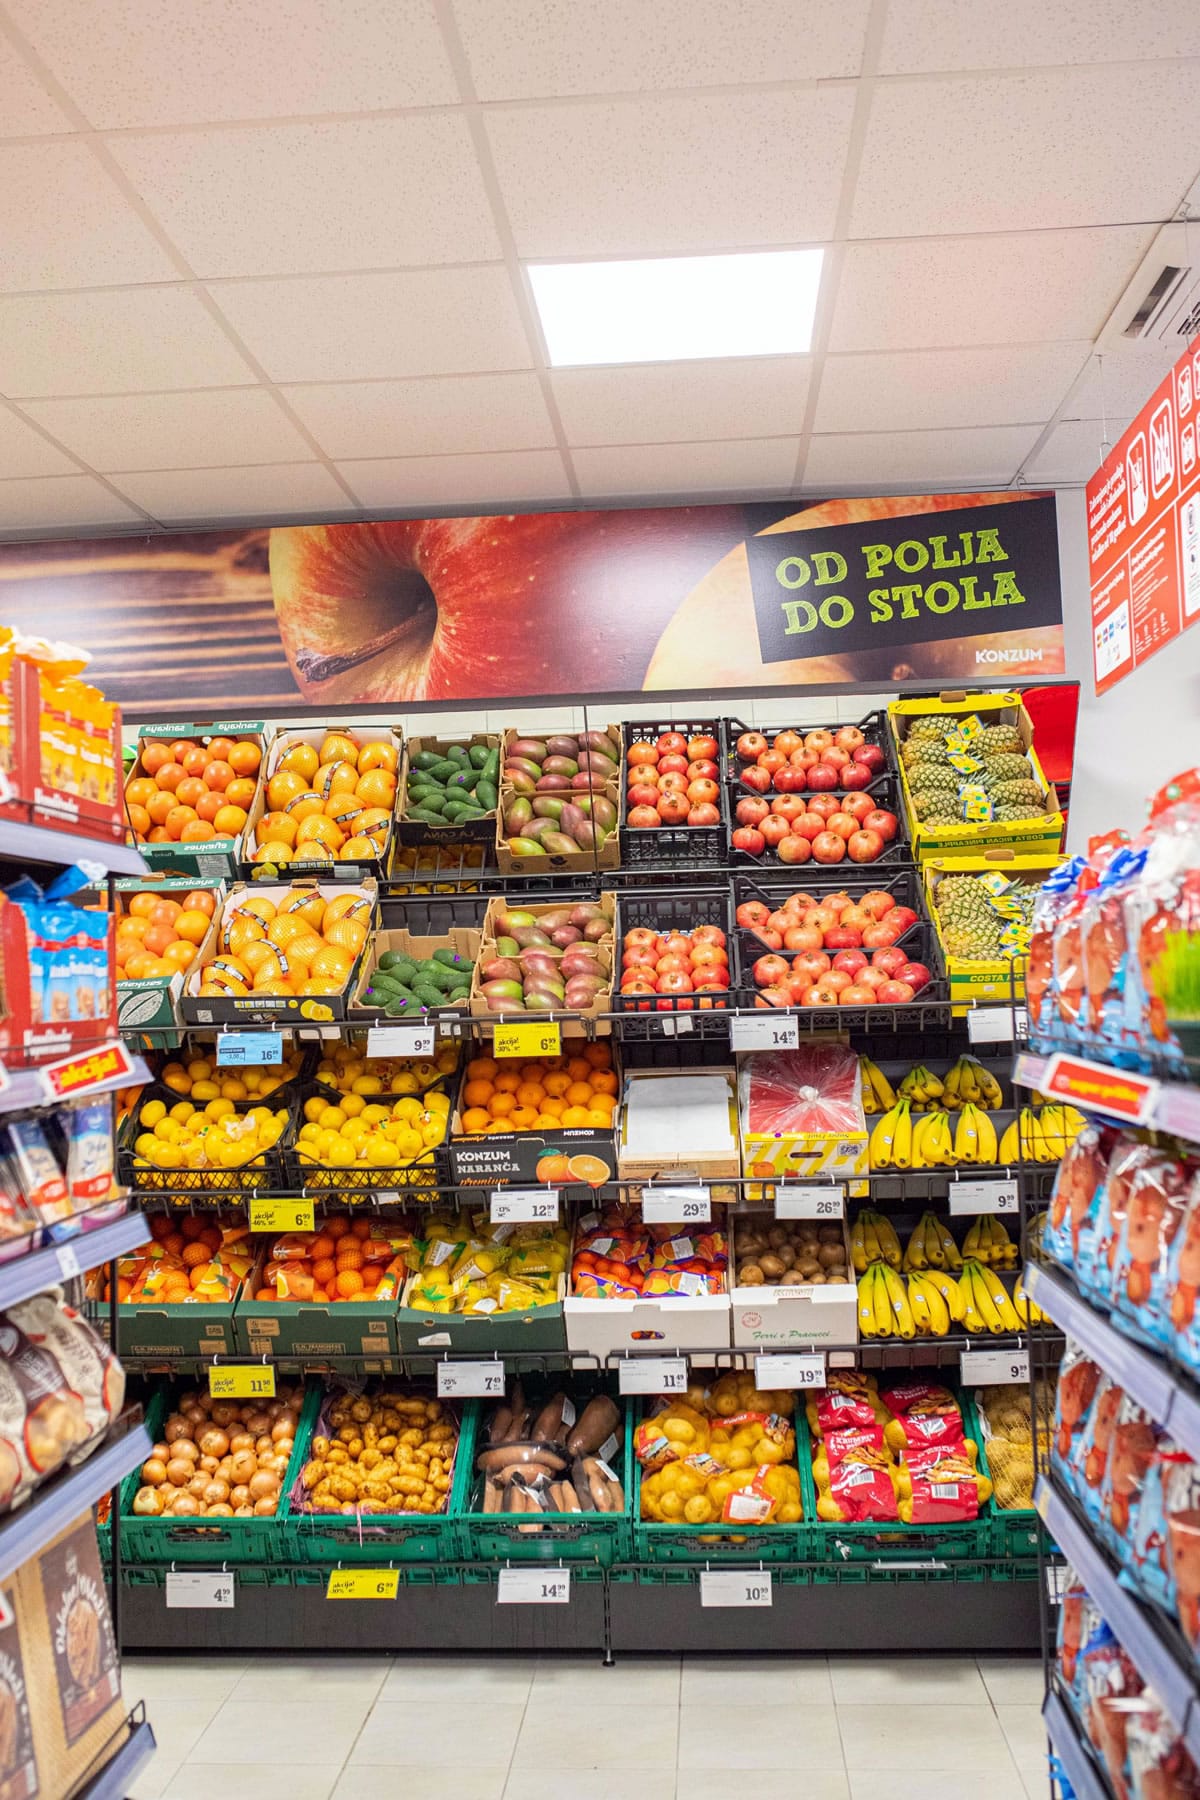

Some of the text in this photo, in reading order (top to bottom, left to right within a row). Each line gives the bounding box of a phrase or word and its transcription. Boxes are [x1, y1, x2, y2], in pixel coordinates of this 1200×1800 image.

[775, 528, 1009, 590] OD POLJA
[781, 571, 1026, 635] DO STOLA
[975, 648, 1043, 664] KONZUM
[169, 878, 214, 887] sankaya
[970, 974, 1004, 983] COSTA
[456, 1151, 511, 1162] KONZUM
[457, 1162, 521, 1174] NARANČA
